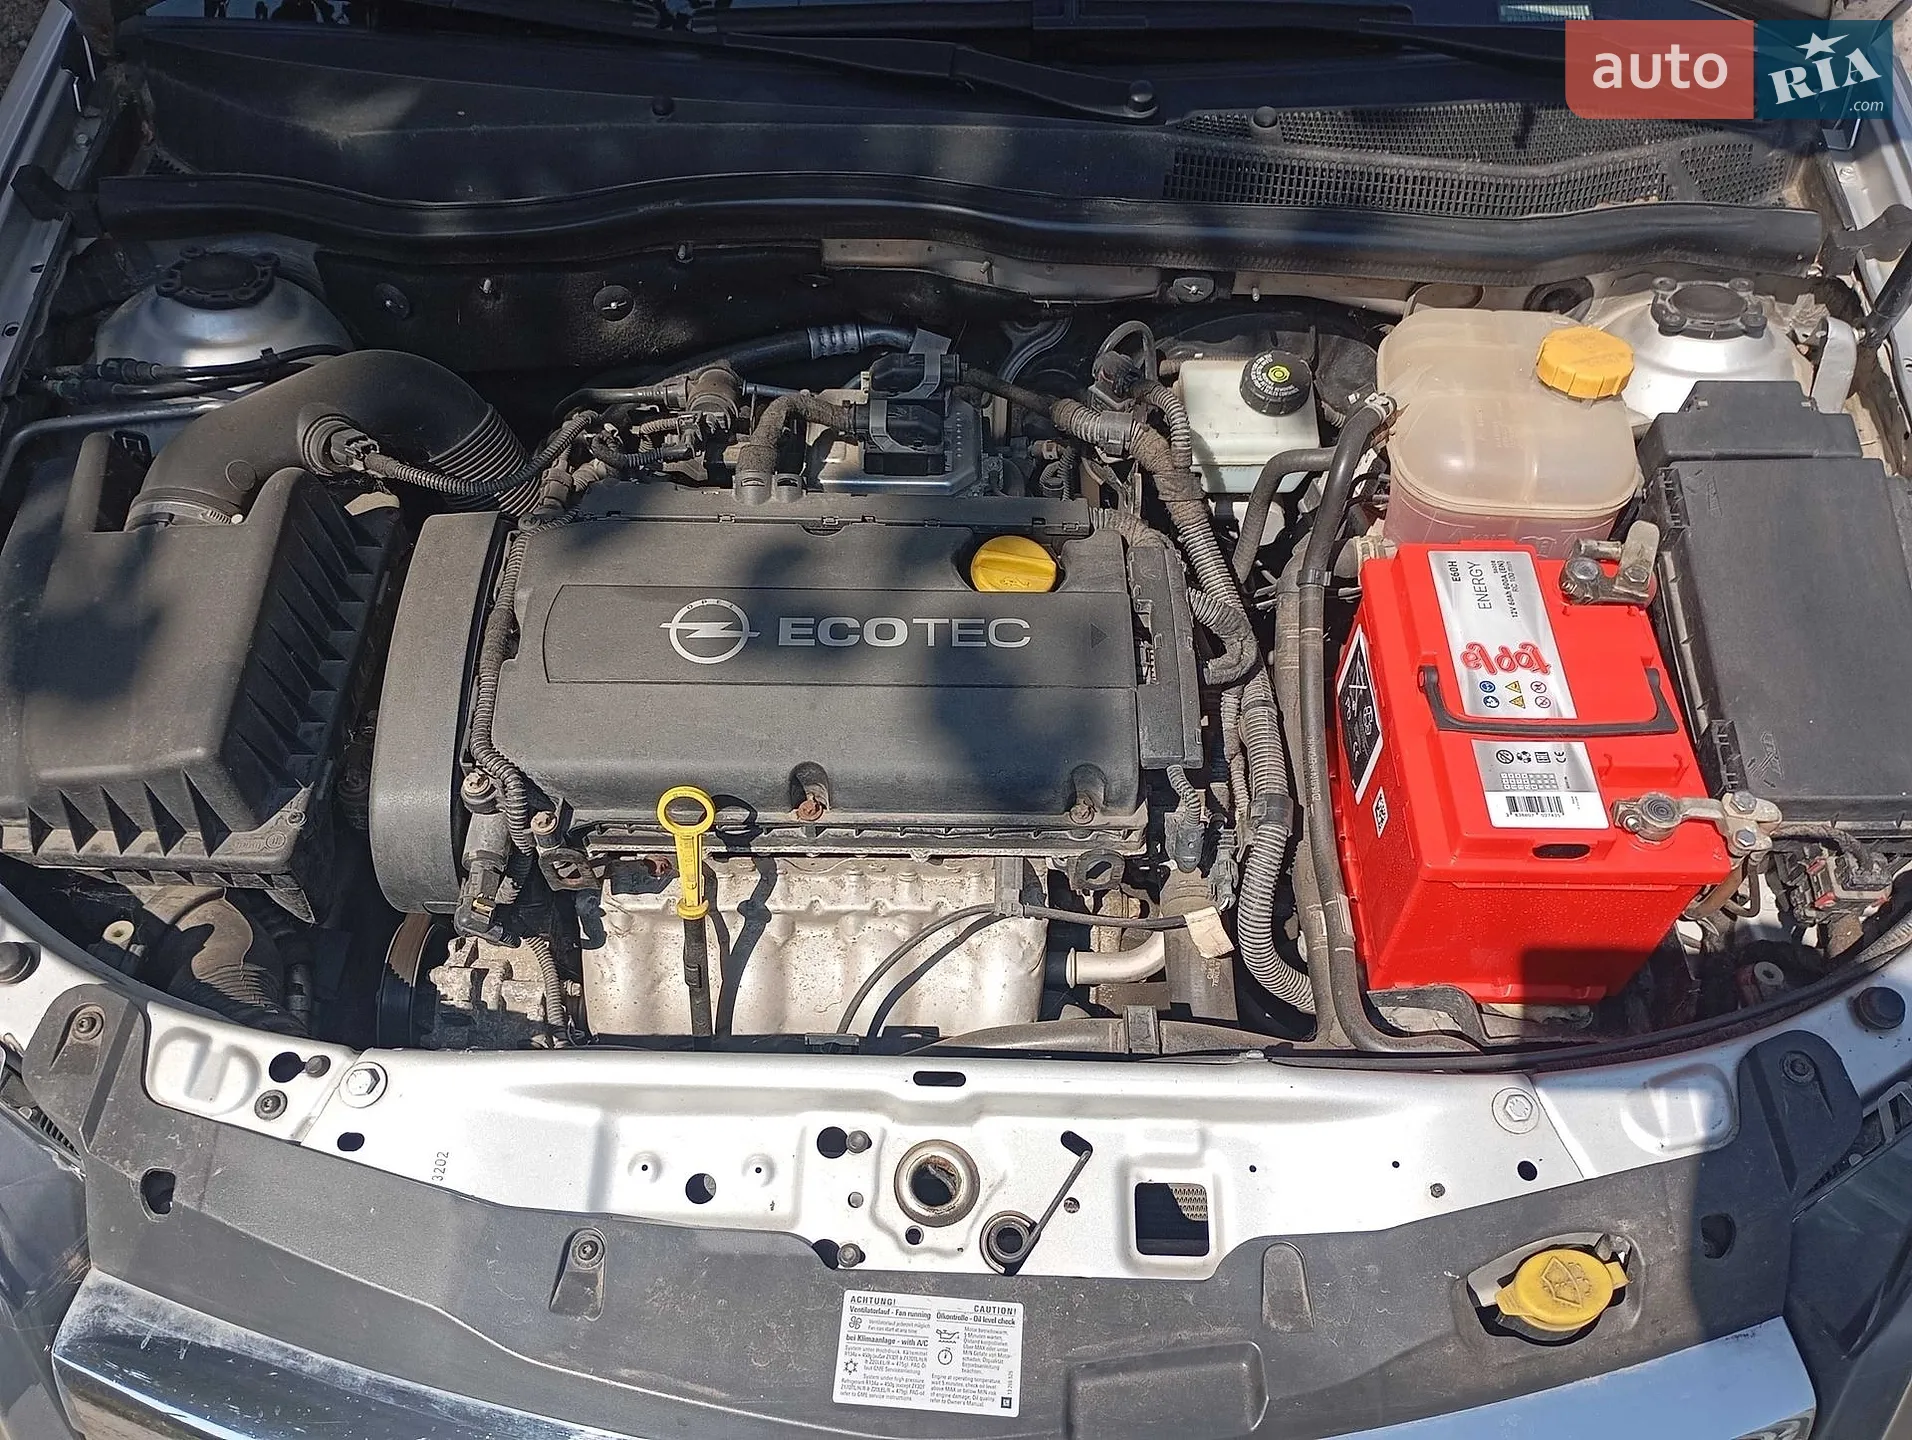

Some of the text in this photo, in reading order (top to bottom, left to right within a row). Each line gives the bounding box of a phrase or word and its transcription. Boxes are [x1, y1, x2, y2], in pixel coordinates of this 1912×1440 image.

[1448, 561, 1461, 582] E60H
[1467, 561, 1492, 610] ENERGY
[777, 616, 1031, 648] ECOTEC
[431, 1151, 449, 1181] 3202
[850, 1296, 896, 1306] ACHTUNG!
[908, 1311, 931, 1320] running
[974, 1305, 1016, 1315] CAUTION!
[998, 1317, 1015, 1325] check
[857, 1335, 896, 1345] Klimaanlage
[901, 1338, 915, 1346] with
